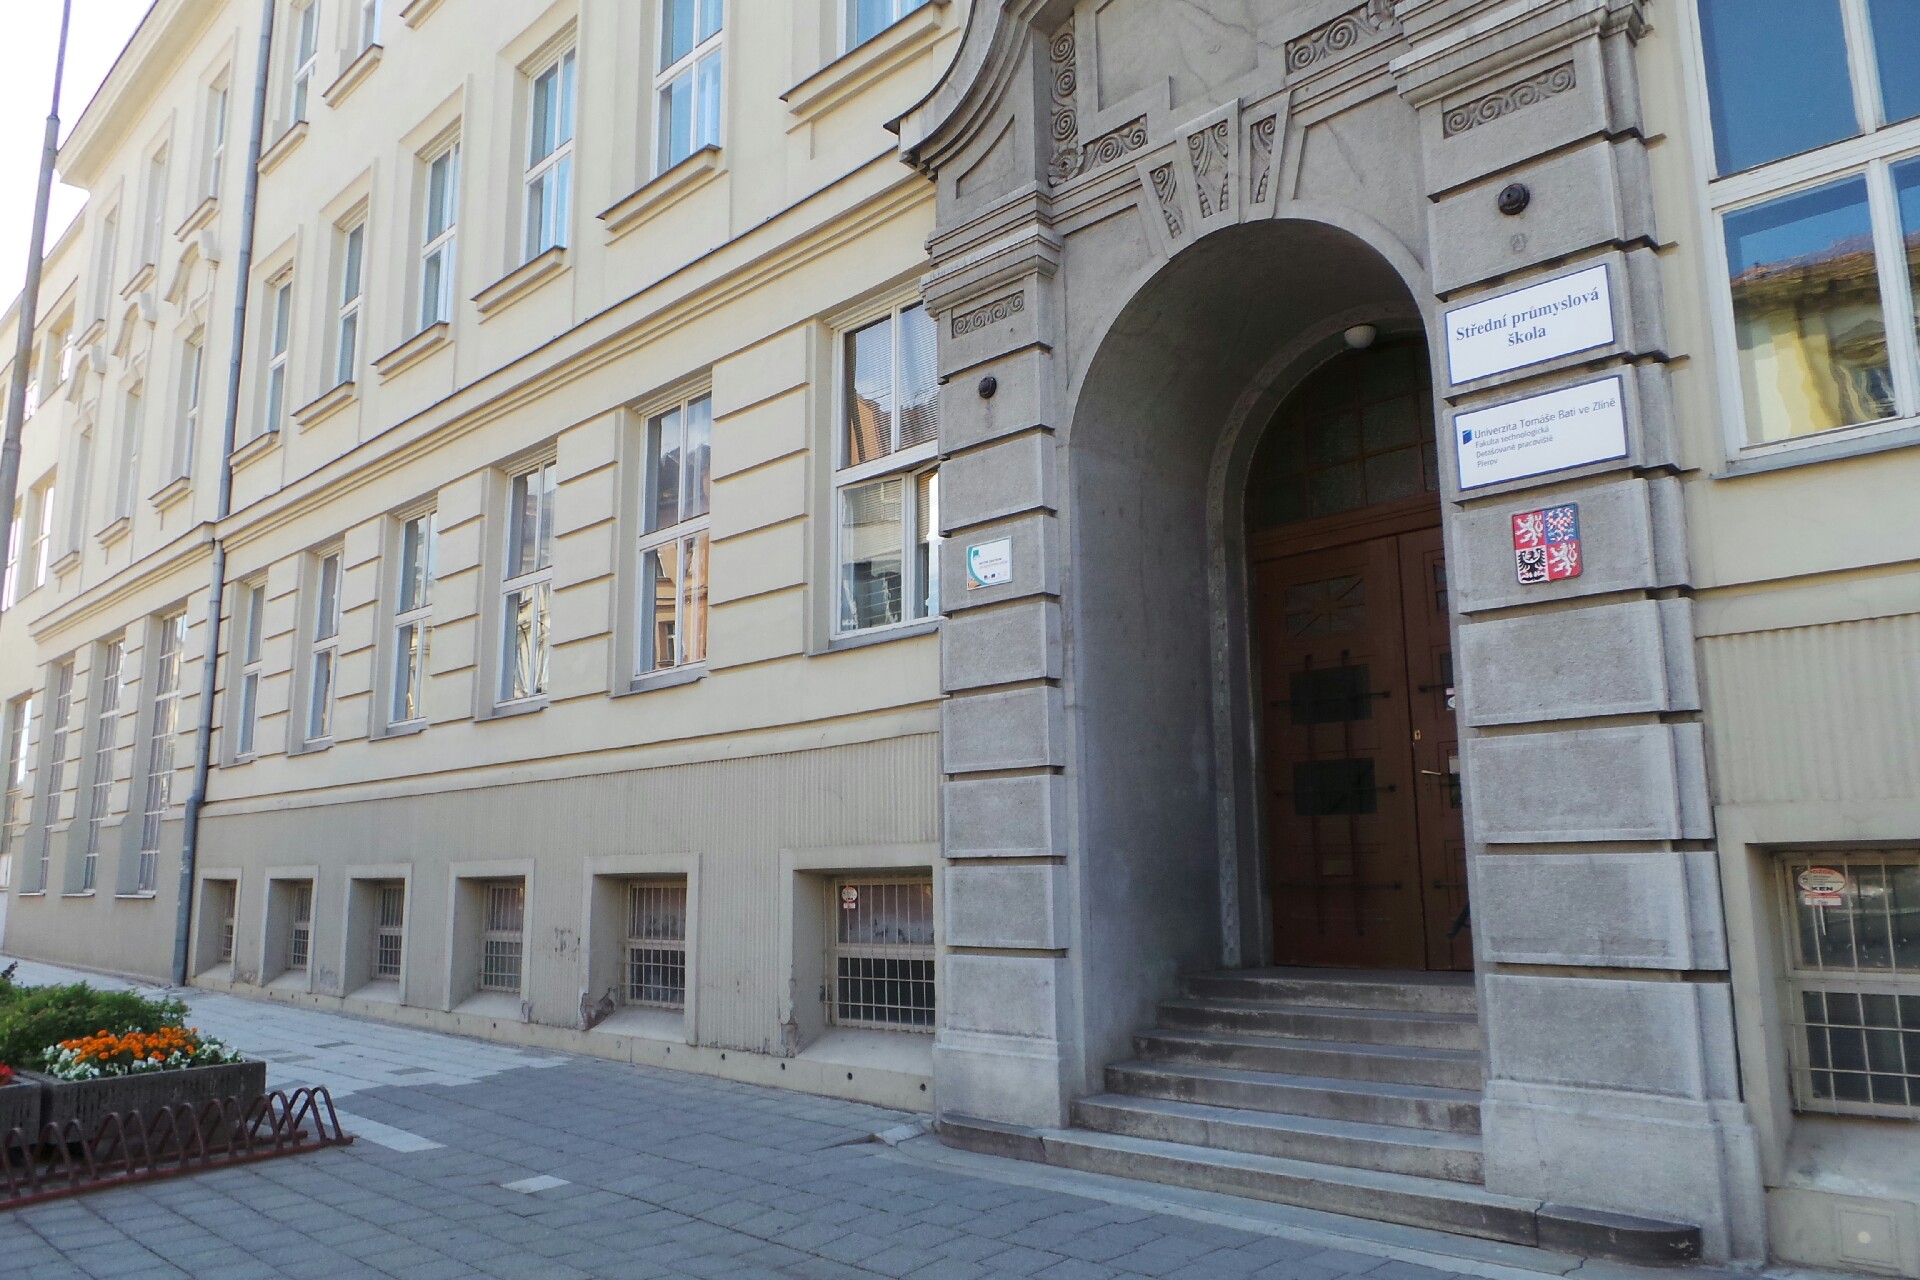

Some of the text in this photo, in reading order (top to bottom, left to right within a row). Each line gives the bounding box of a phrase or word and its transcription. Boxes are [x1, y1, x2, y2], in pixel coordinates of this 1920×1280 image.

[1456, 286, 1600, 341] Střední průmyslová
[1507, 325, 1547, 347] škola
[1474, 398, 1616, 439] Univerzita Tomáše Bati ve Zlíně
[1475, 425, 1550, 449] Fakulta technologická
